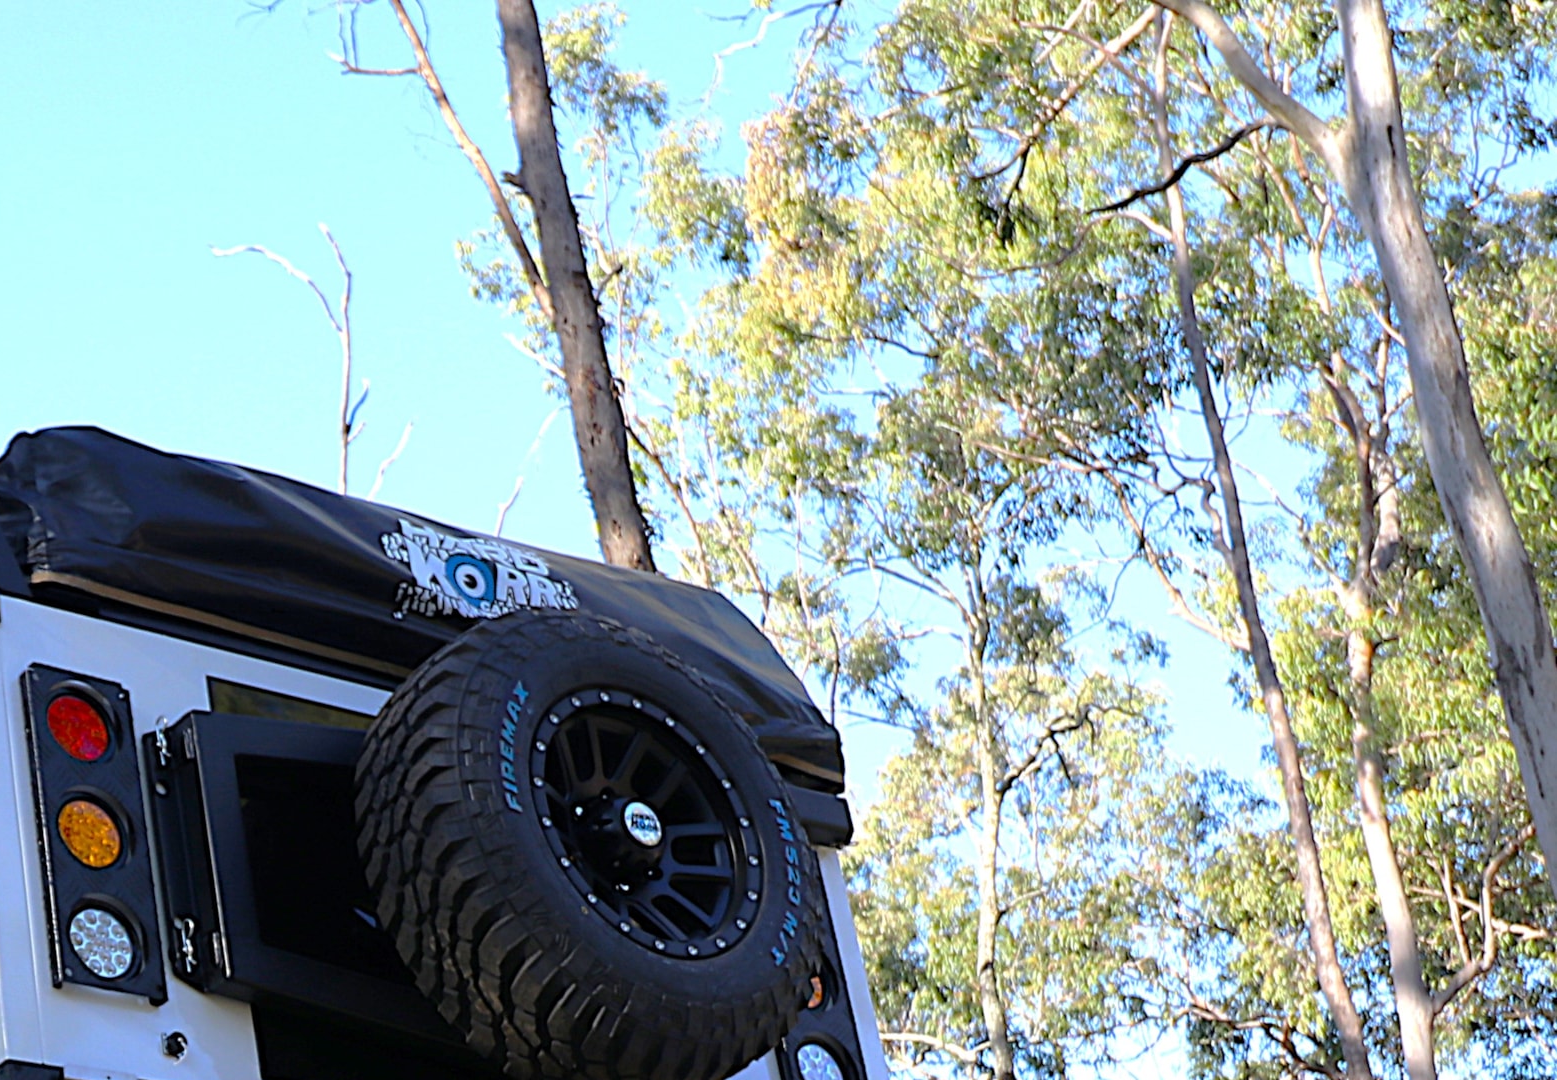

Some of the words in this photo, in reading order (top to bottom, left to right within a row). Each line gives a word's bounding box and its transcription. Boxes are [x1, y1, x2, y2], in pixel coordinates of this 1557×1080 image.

[500, 680, 529, 813] FIREMAX
[769, 799, 801, 906] FM523
[771, 911, 798, 967] M/T
